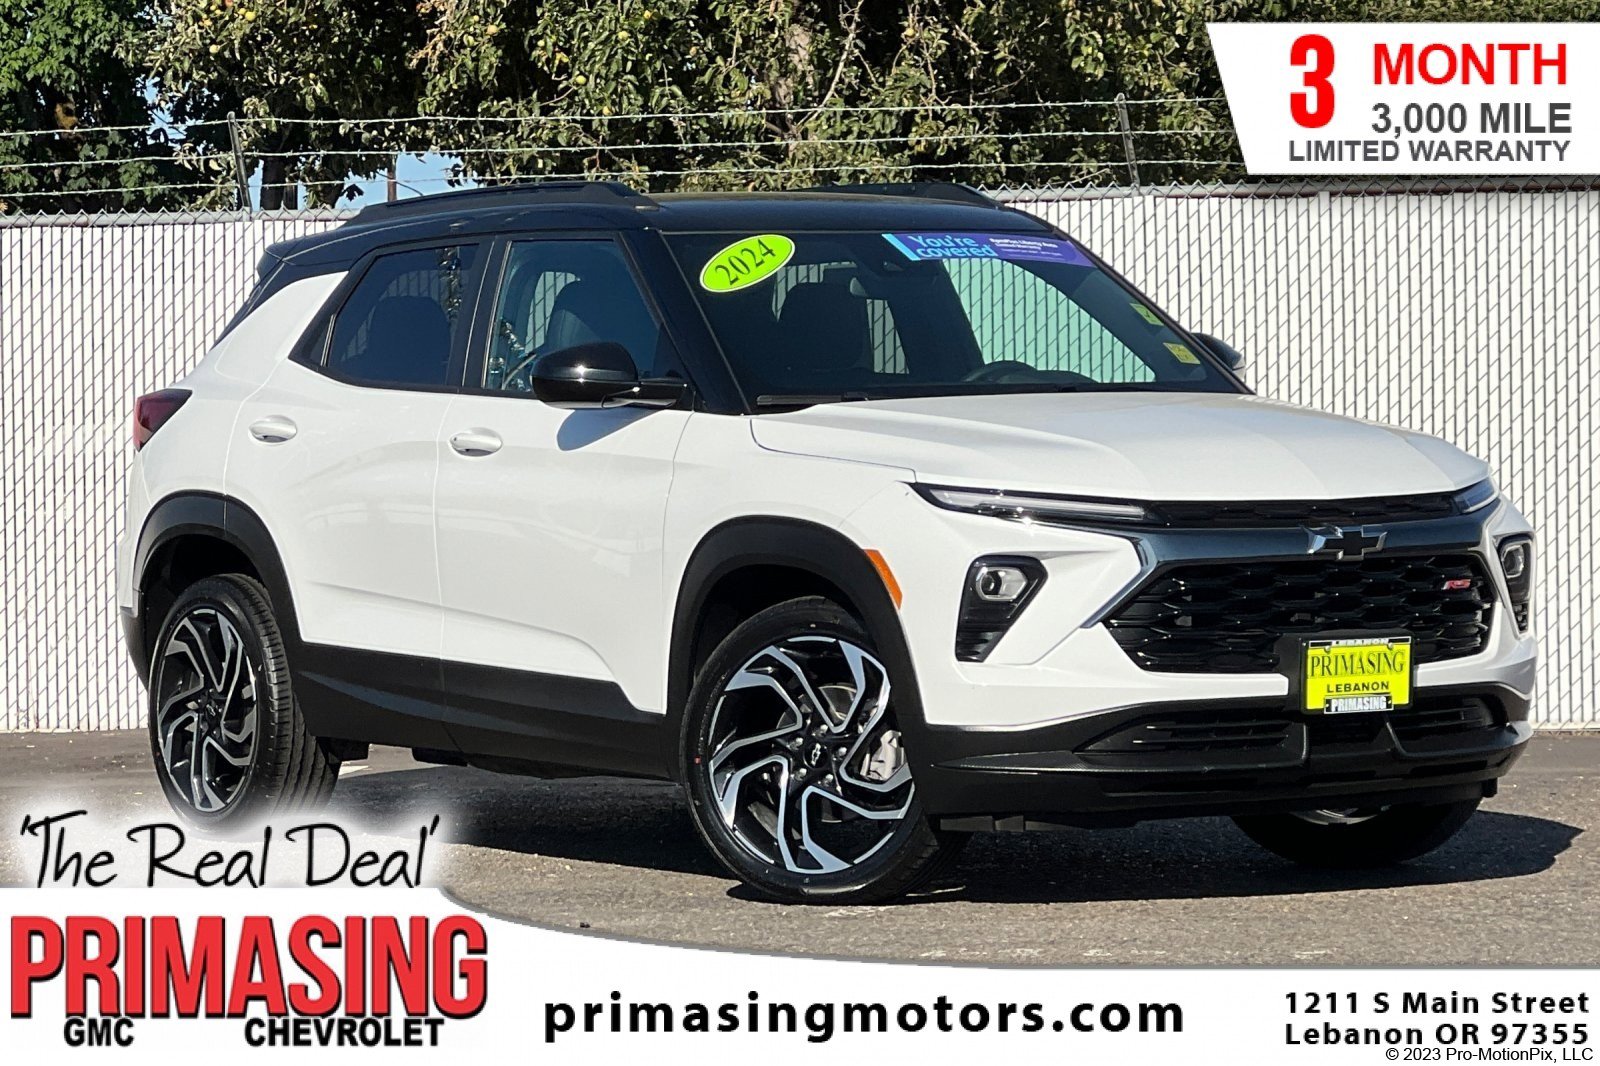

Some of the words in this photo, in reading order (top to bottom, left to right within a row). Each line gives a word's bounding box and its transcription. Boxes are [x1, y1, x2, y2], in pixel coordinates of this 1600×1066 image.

[907, 234, 979, 247] You're
[916, 244, 999, 257] covered
[715, 239, 776, 286] 2024
[1310, 649, 1406, 678] PRIMASING
[1326, 681, 1389, 693] LEBANON
[1331, 696, 1388, 713] PRIMASING
